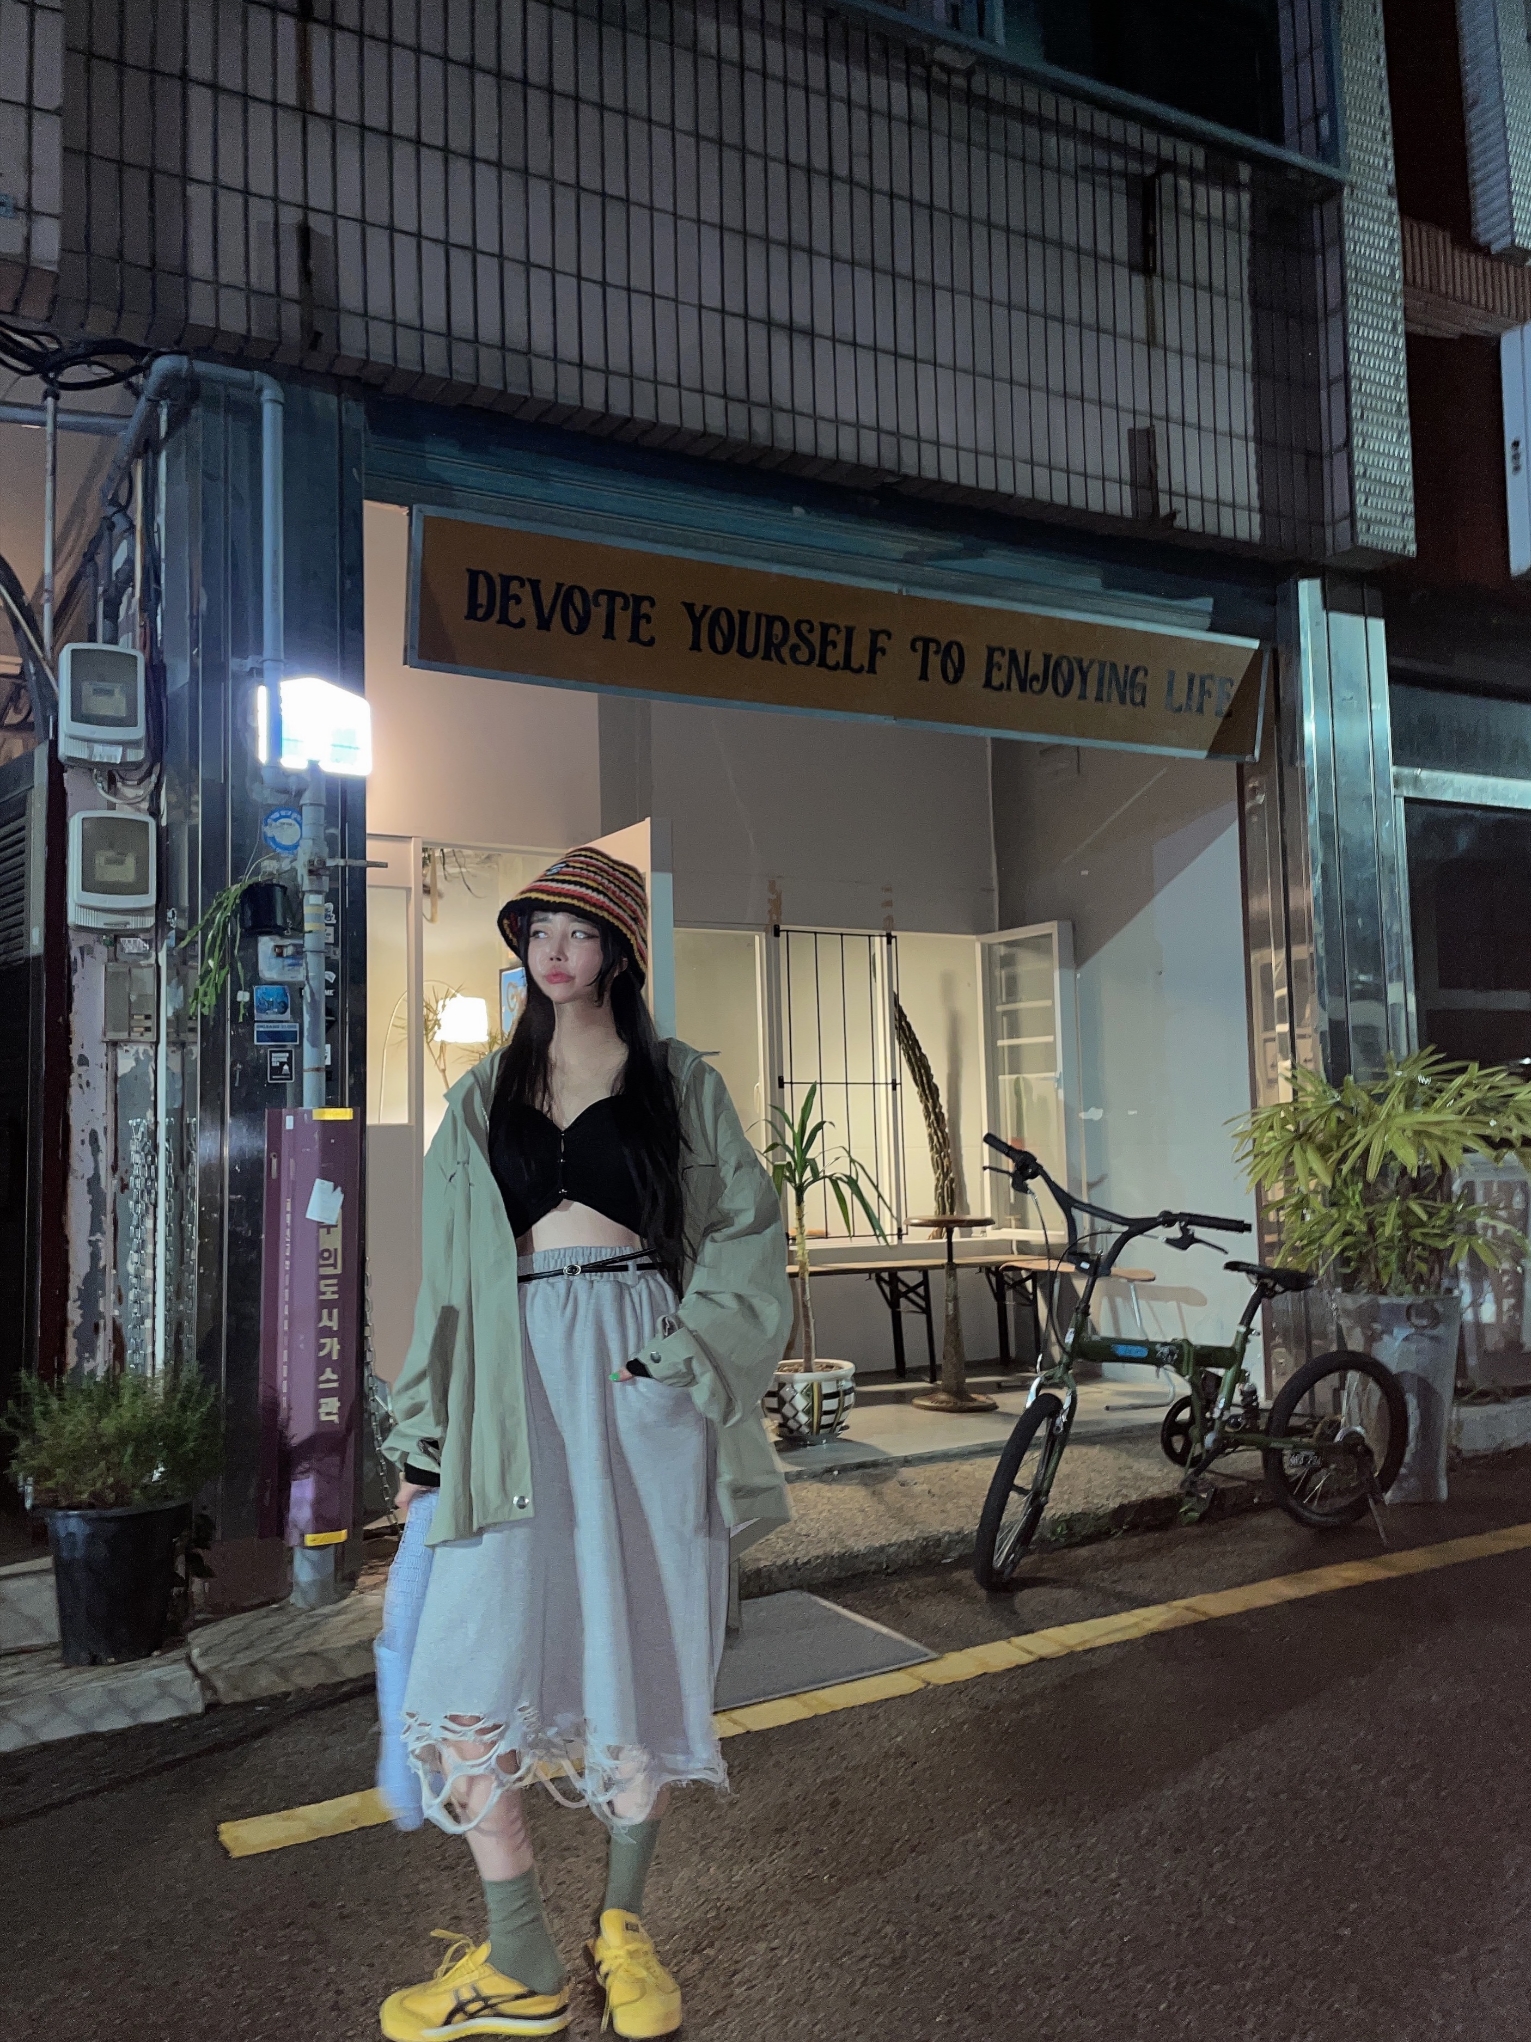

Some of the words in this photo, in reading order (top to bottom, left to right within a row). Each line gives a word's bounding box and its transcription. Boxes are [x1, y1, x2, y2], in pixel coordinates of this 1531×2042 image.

[464, 568, 656, 647] DEVOTE
[681, 601, 892, 674] YOURSELF
[910, 634, 966, 685] TO
[982, 644, 1149, 709] ENJOYING
[1164, 669, 1235, 718] LIFE
